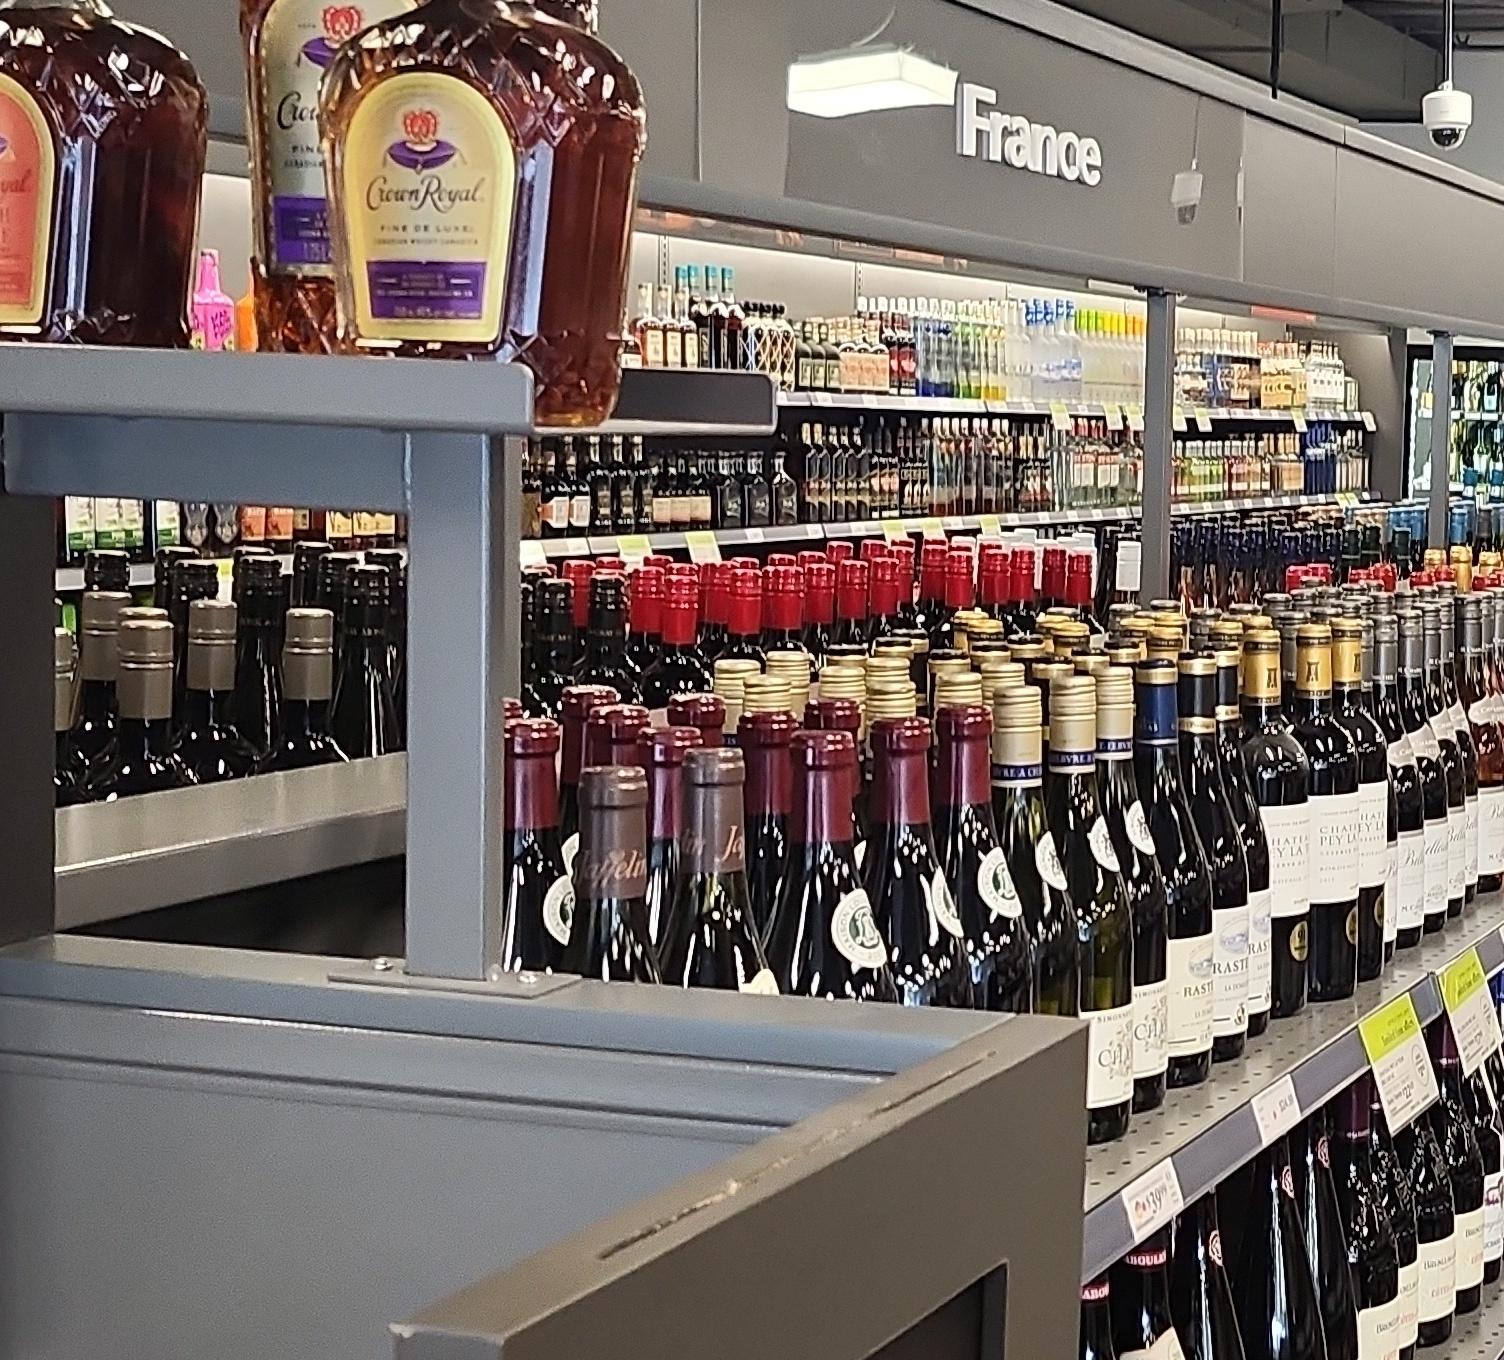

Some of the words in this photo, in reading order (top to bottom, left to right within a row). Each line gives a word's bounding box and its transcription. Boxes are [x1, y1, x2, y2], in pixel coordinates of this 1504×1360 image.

[956, 83, 1102, 187] France
[366, 176, 420, 211] Crown
[410, 175, 485, 213] Royal
